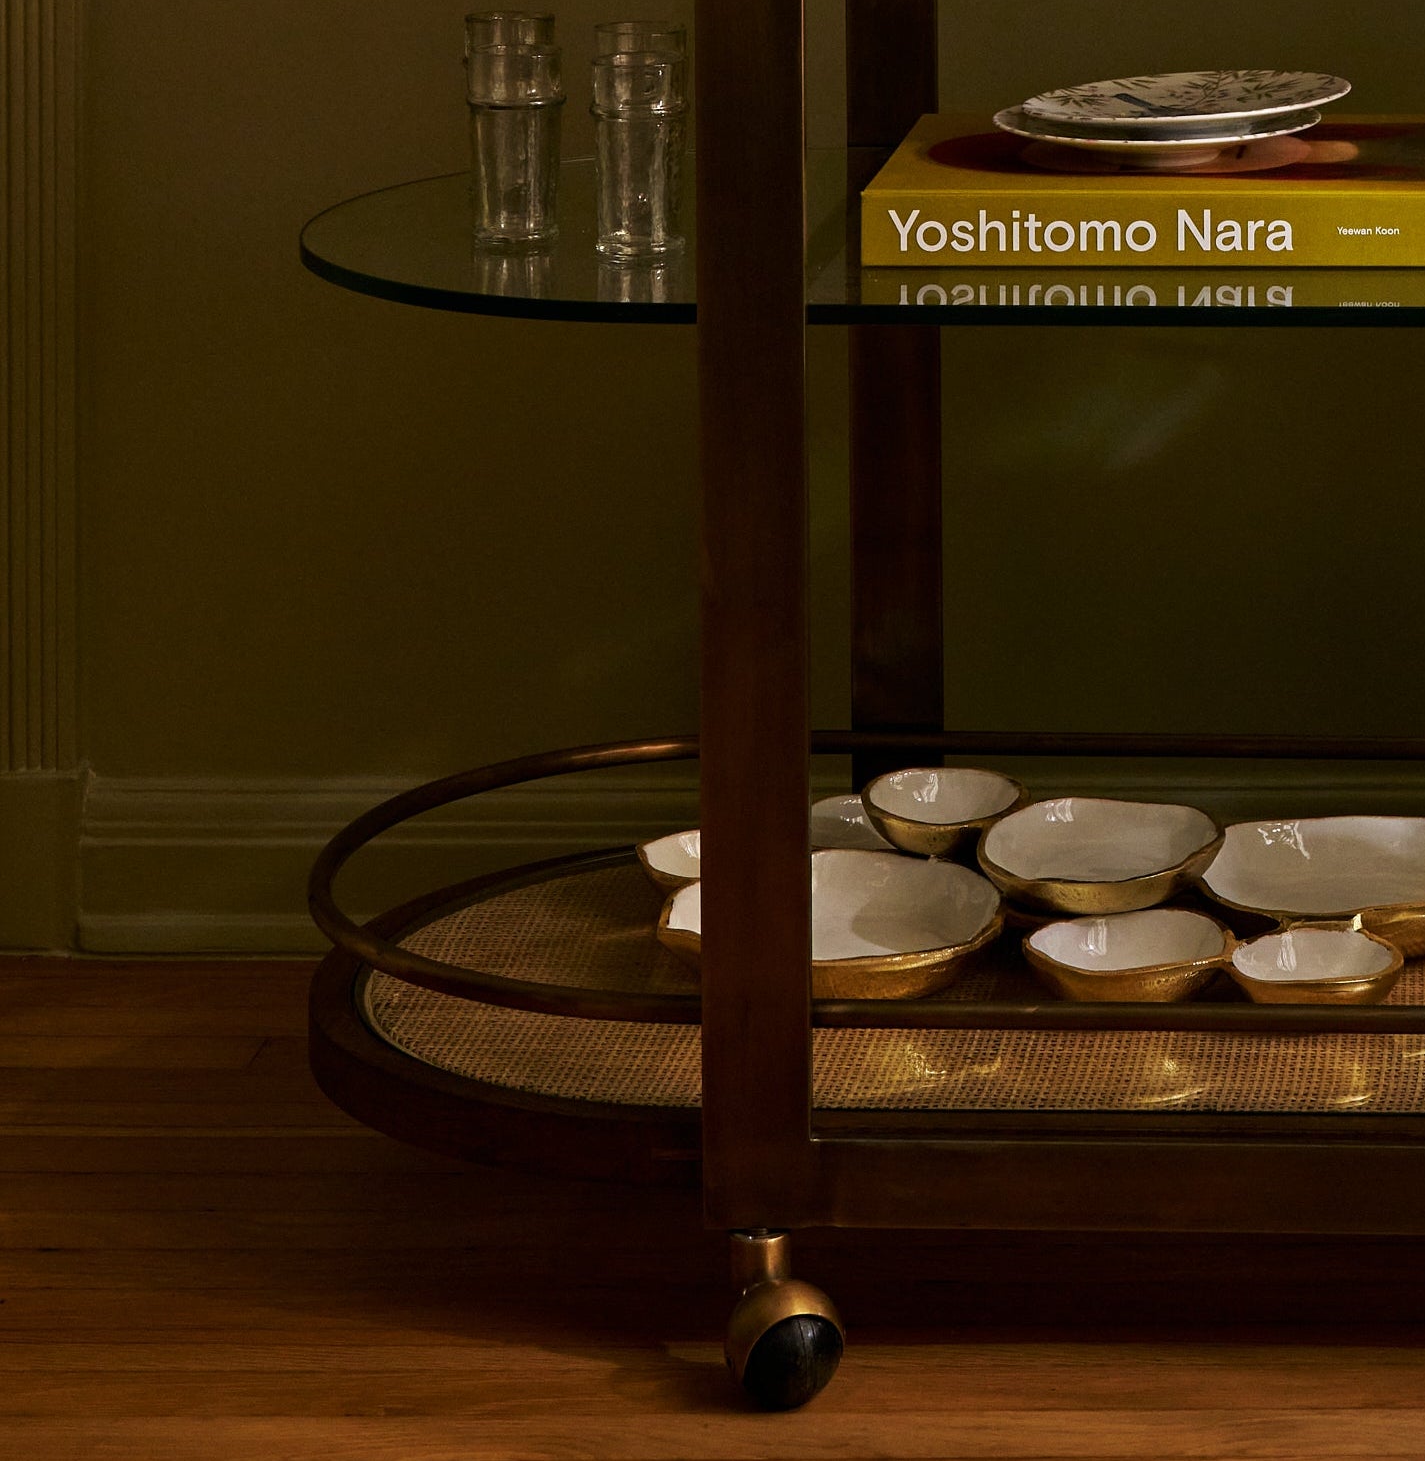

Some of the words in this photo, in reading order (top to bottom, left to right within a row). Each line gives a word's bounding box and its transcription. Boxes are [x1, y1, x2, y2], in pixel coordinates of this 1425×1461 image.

[888, 209, 1157, 253] Yoshitomo
[1177, 209, 1294, 253] Nara
[1337, 226, 1373, 236] Yeewan
[1375, 226, 1400, 236] Koon
